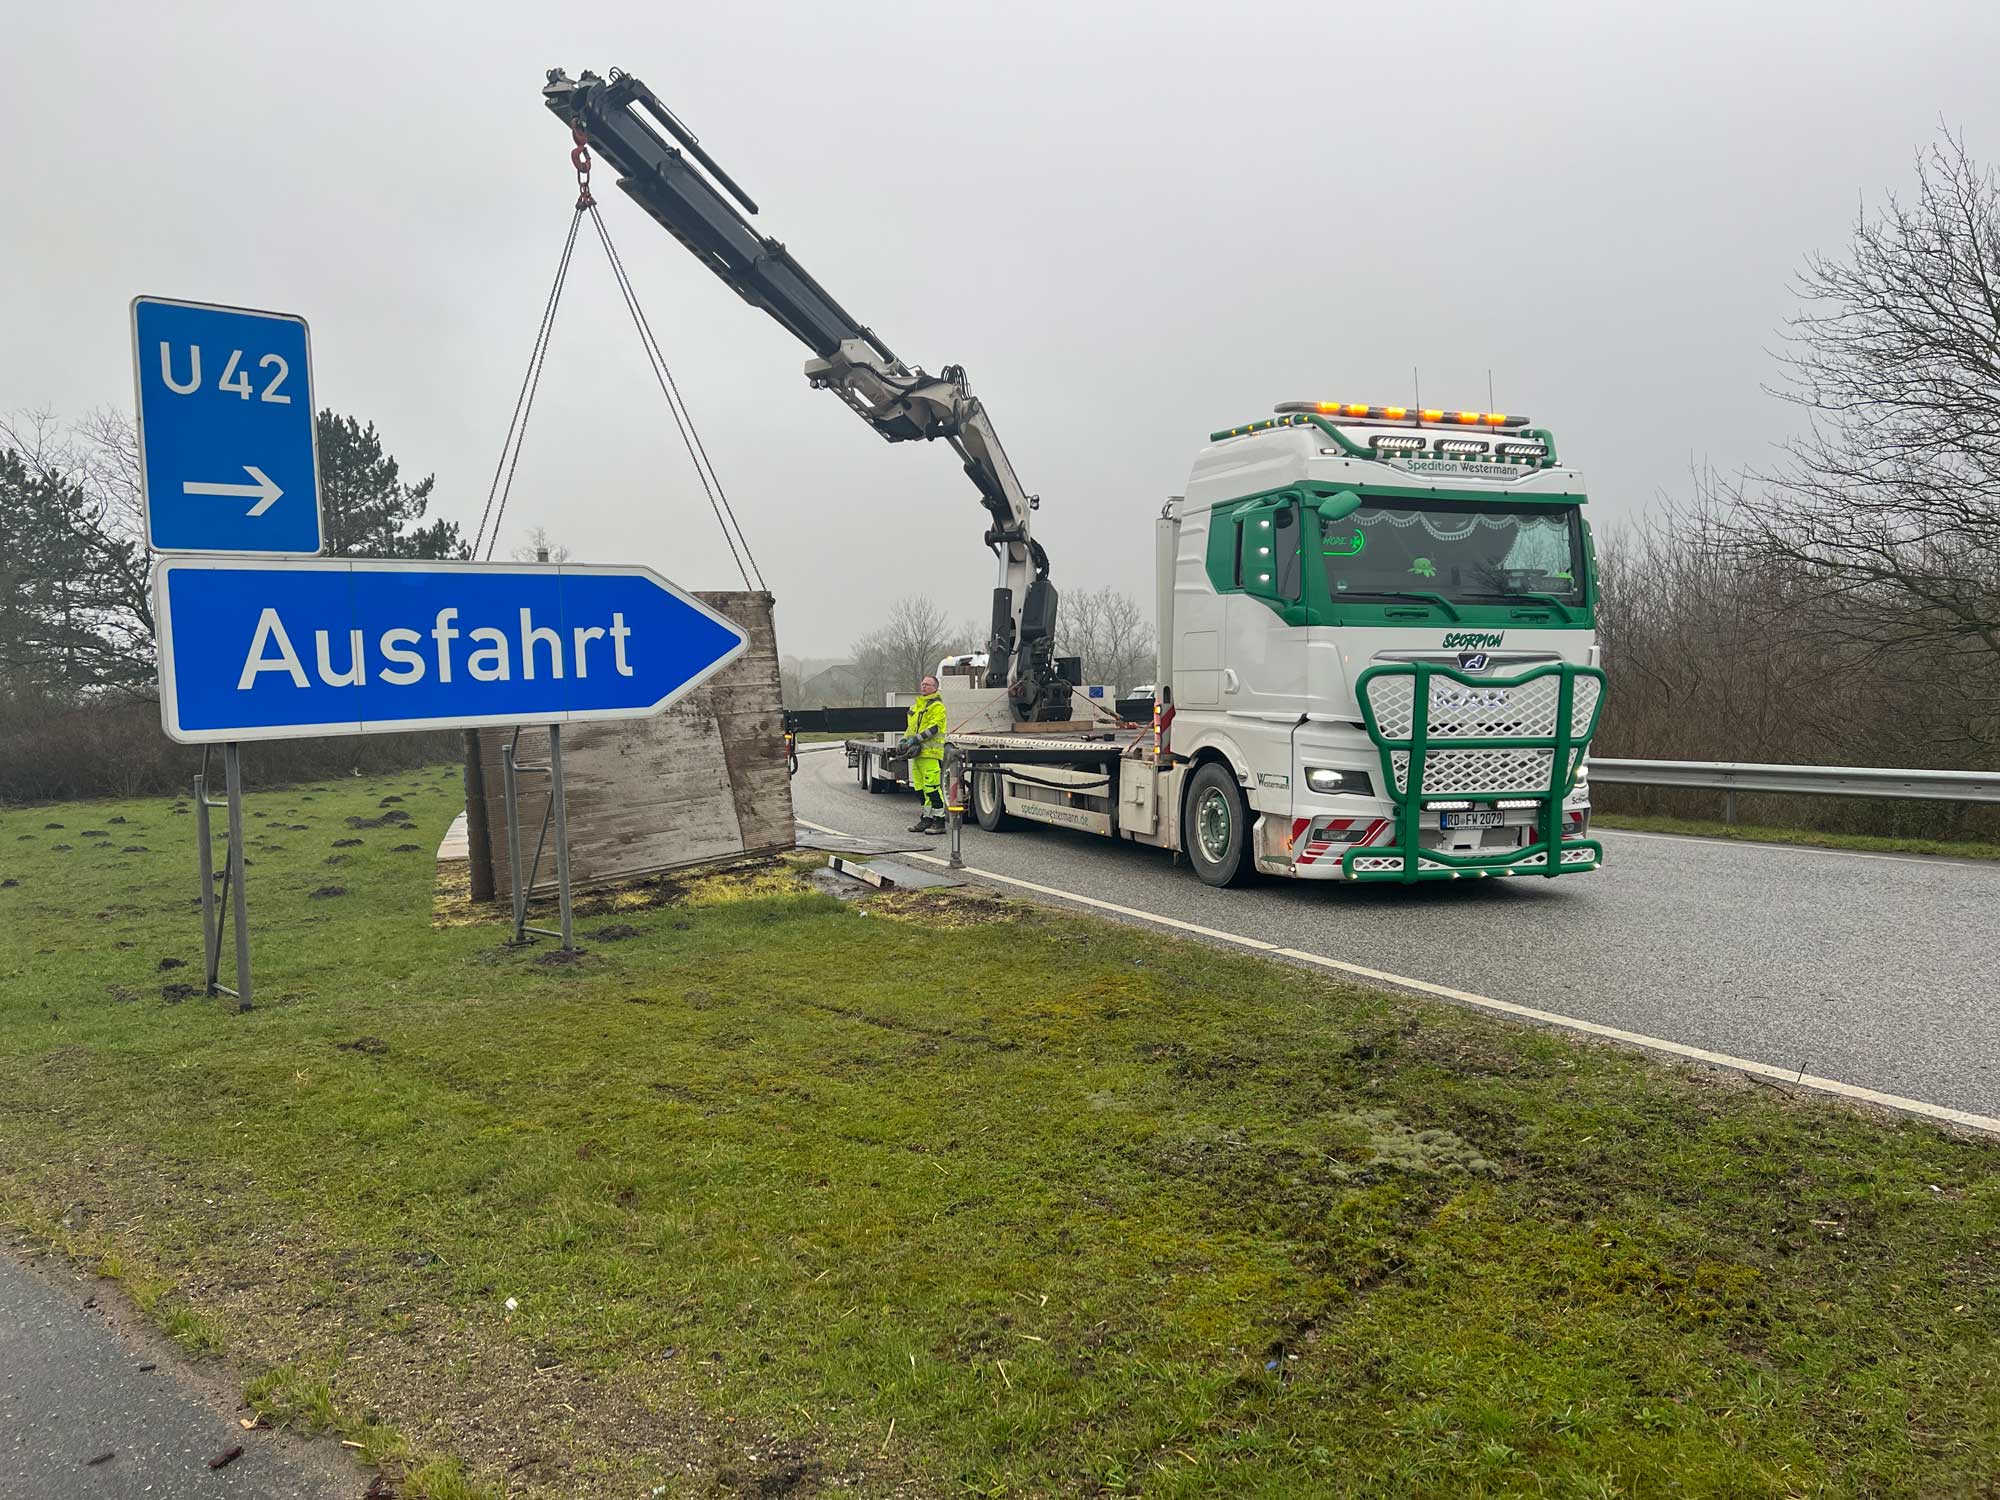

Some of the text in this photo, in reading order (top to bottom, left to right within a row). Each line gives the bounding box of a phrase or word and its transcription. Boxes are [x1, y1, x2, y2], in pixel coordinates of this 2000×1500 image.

[160, 341, 291, 404] U 42
[1407, 459, 1518, 475] Spedition Westermann
[237, 607, 634, 690] Ausfahrt
[1442, 630, 1505, 652] SCORPION
[1448, 814, 1459, 825] RD
[1480, 812, 1502, 824] 2079
